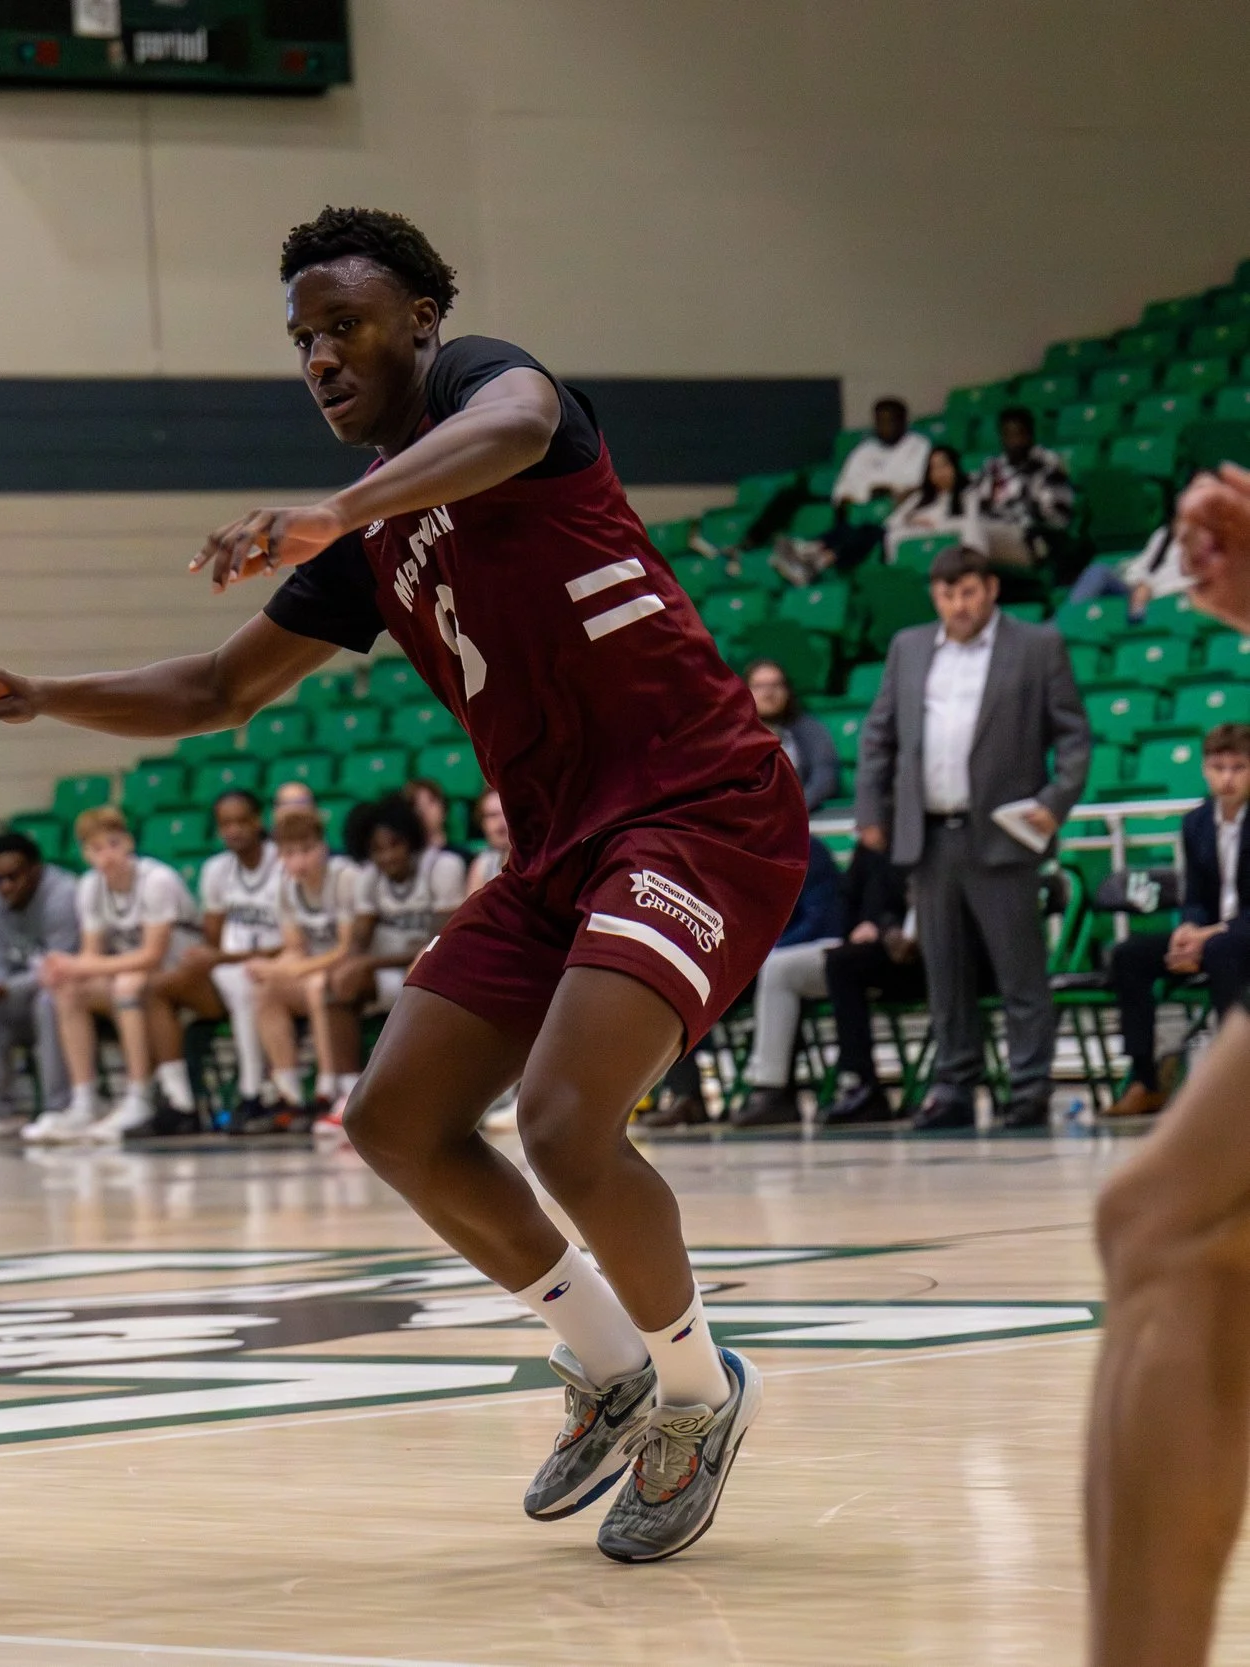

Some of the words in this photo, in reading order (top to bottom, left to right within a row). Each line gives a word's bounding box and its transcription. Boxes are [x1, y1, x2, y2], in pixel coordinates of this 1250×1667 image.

[635, 890, 714, 953] GRIFFINS
[646, 874, 686, 902] MacEwan
[686, 897, 721, 928] University
